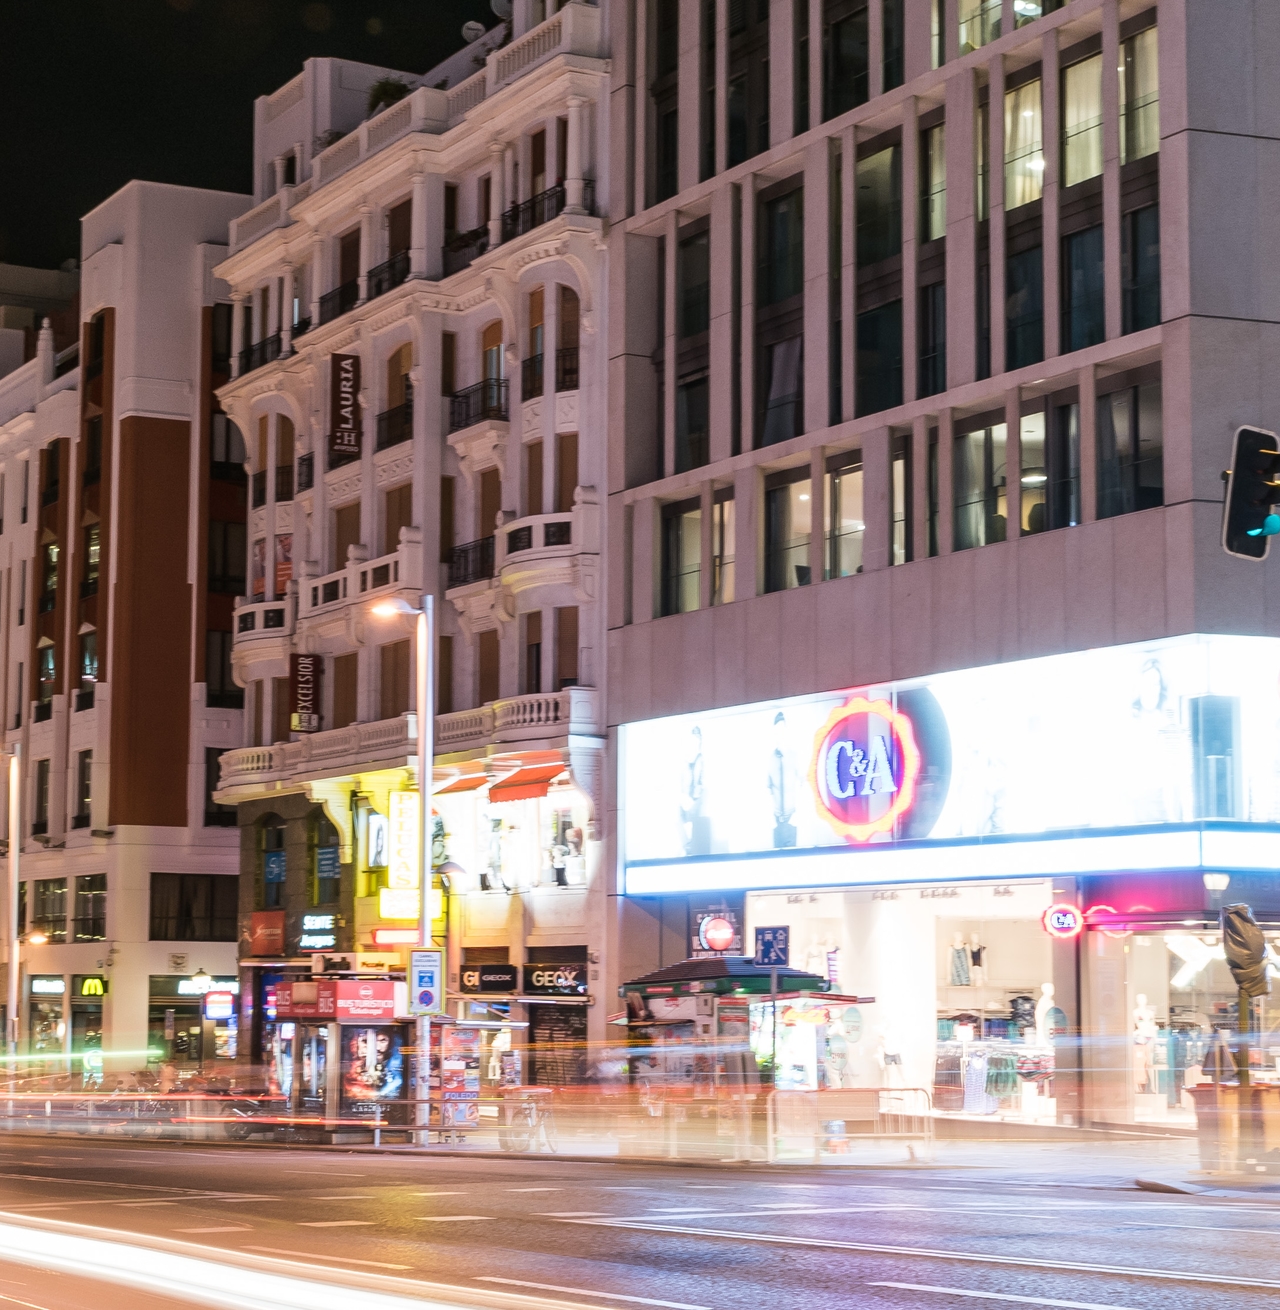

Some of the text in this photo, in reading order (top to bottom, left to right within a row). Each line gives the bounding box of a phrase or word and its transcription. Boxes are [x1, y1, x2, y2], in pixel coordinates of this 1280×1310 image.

[340, 359, 354, 429] LAURIA
[297, 656, 314, 714] EXCELSIOR
[826, 735, 898, 799] C&A
[396, 793, 413, 887] PELUCAS
[482, 974, 512, 982] GEOX
[532, 971, 580, 987] GEOX
[319, 997, 335, 1013] BUS
[445, 1091, 478, 1099] TOLEDO
